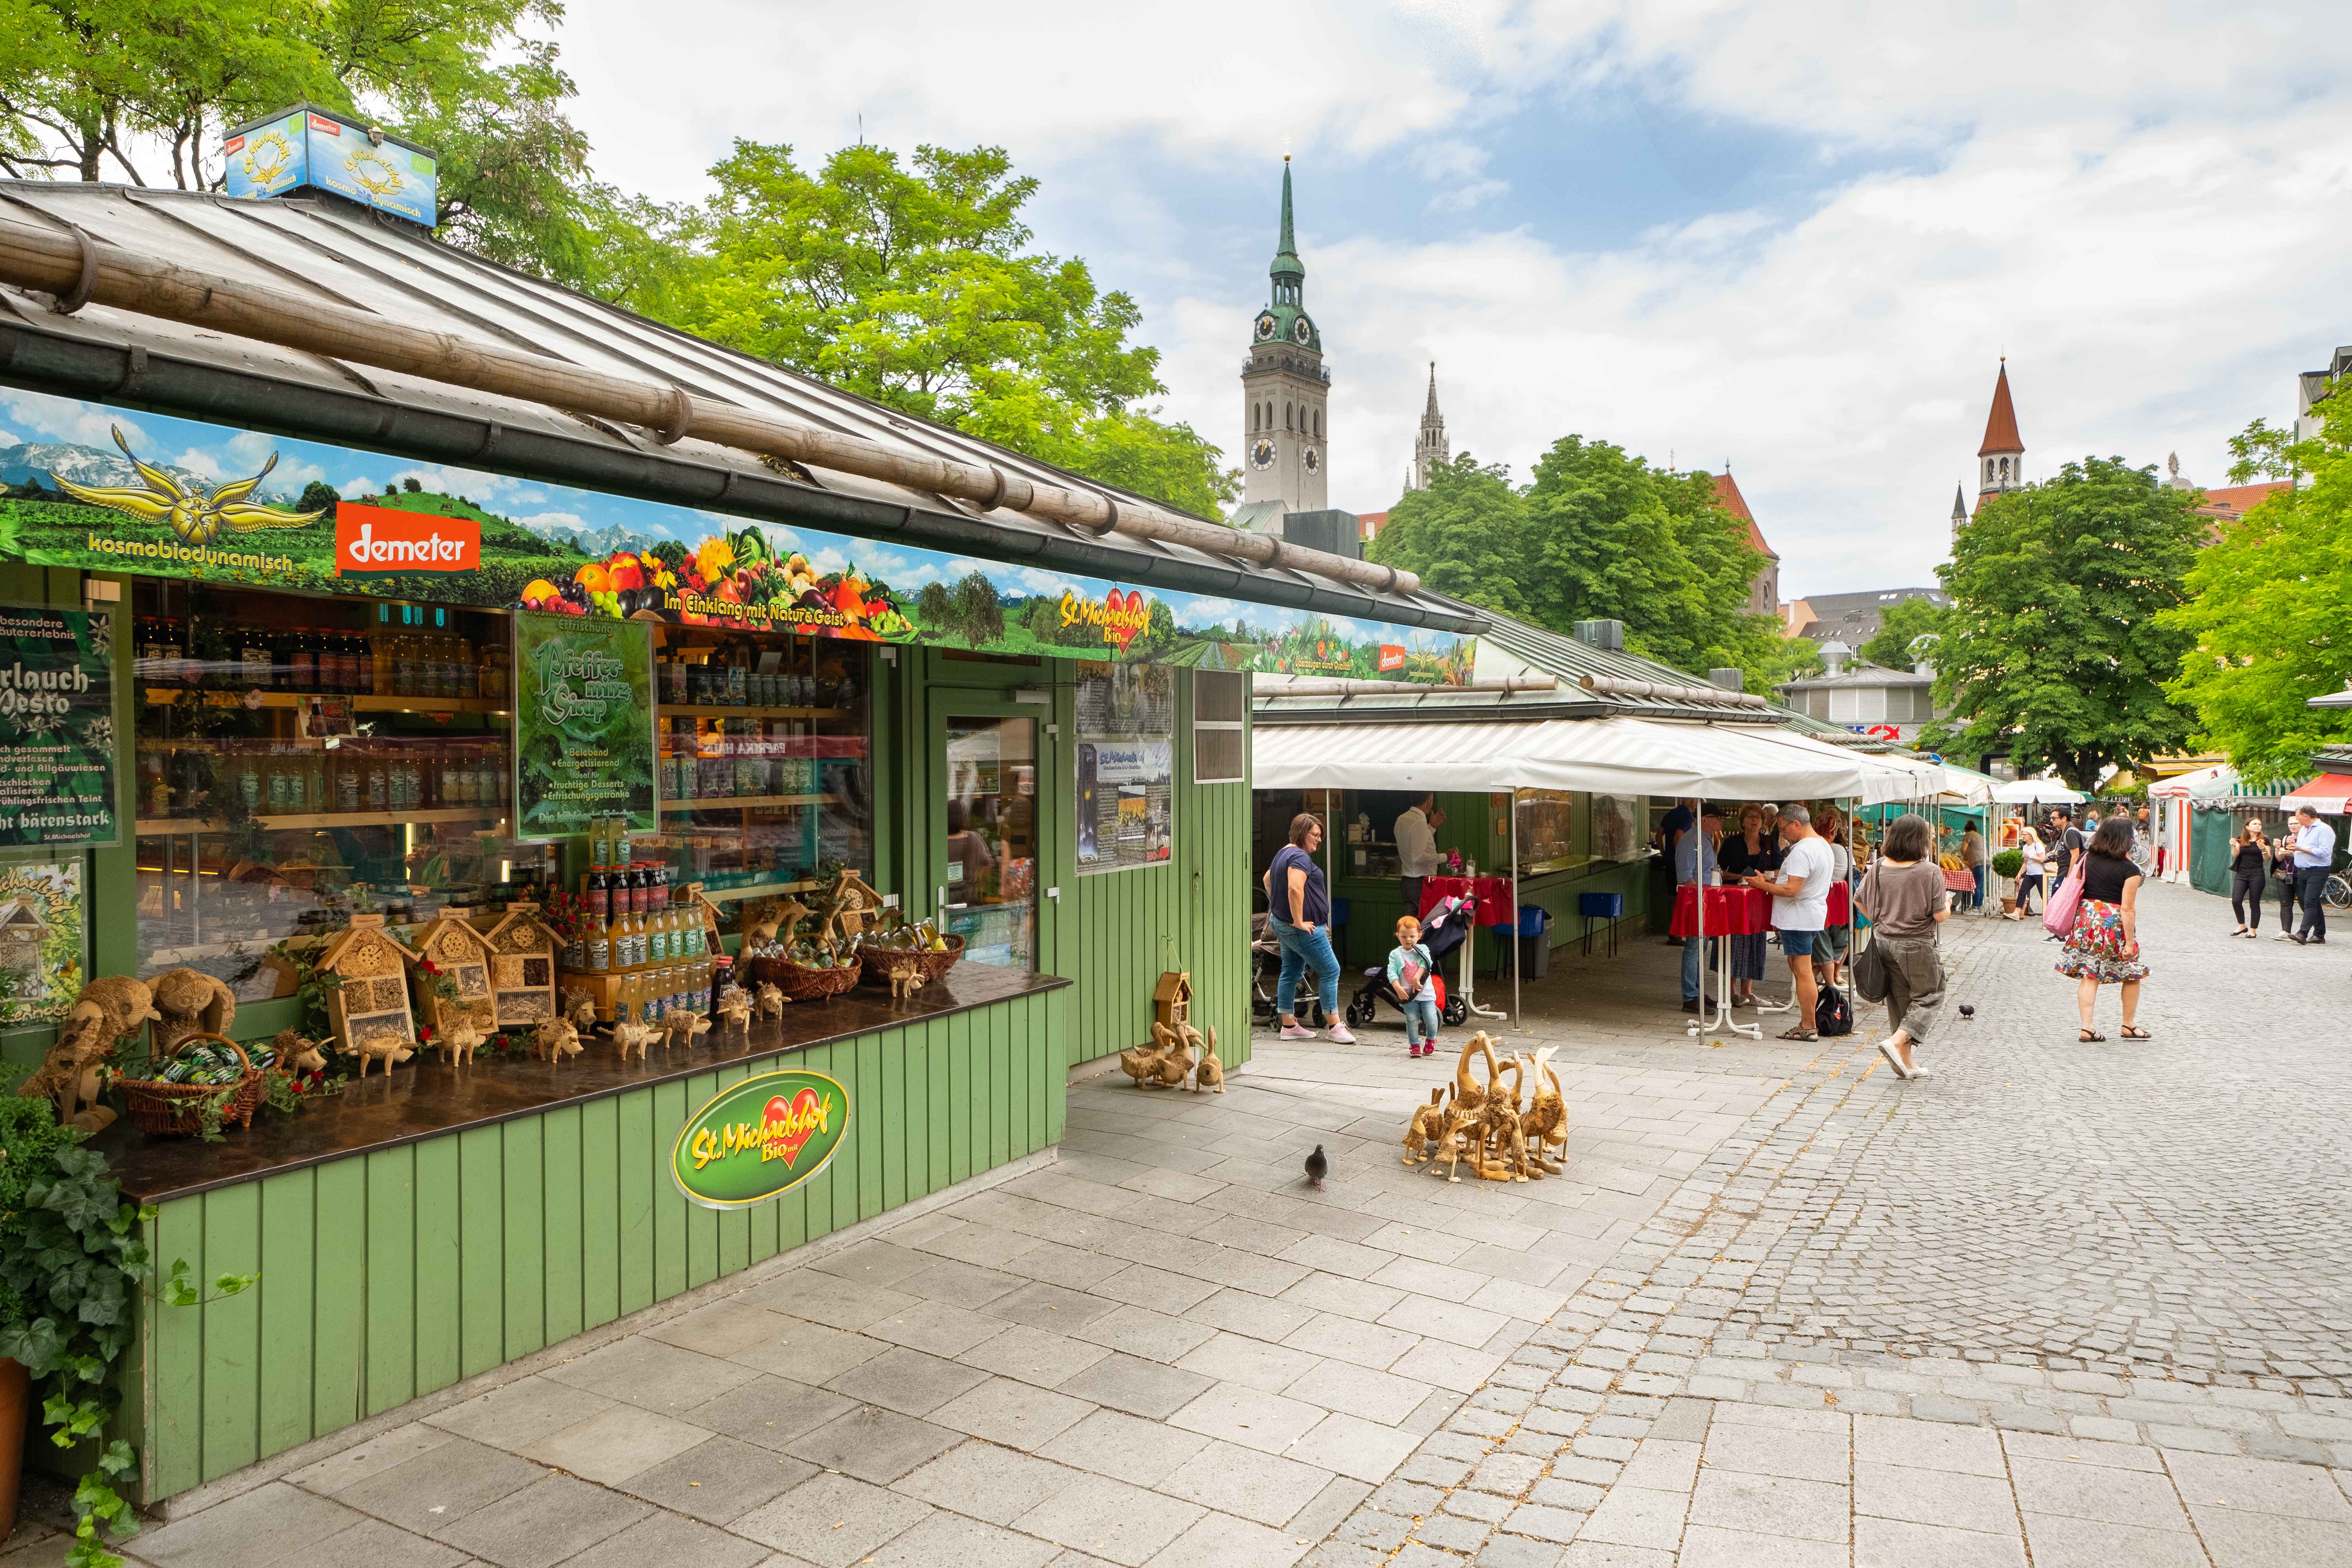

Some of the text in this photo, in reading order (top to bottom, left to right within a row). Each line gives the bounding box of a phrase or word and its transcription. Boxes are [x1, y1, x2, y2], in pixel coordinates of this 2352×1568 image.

[311, 119, 338, 133] demeter
[227, 140, 243, 153] demeter
[326, 175, 421, 218] kosmobiodynamisch
[349, 524, 465, 563] demeter
[89, 532, 293, 571] kosmobiodynamisch
[664, 592, 682, 610] Im
[686, 594, 742, 620] Einklang
[747, 604, 767, 619] mit
[0, 615, 64, 628] besondere
[558, 619, 614, 638] Erfrischung
[1103, 626, 1122, 643] Bio
[1322, 659, 1333, 670] durch
[1382, 652, 1403, 668] demeter
[543, 683, 607, 725] Sirup
[14, 746, 71, 755] gesammelt
[570, 748, 609, 757] Belebend
[38, 764, 105, 774] Allgäuwiesen
[557, 759, 620, 770] Energetisierend
[554, 779, 624, 791] fruchtige Desserts
[548, 789, 630, 801] Erfrischungsgetränke
[20, 809, 110, 829] bärenstark
[539, 811, 555, 824] Die
[761, 1143, 798, 1163] Bio mit
